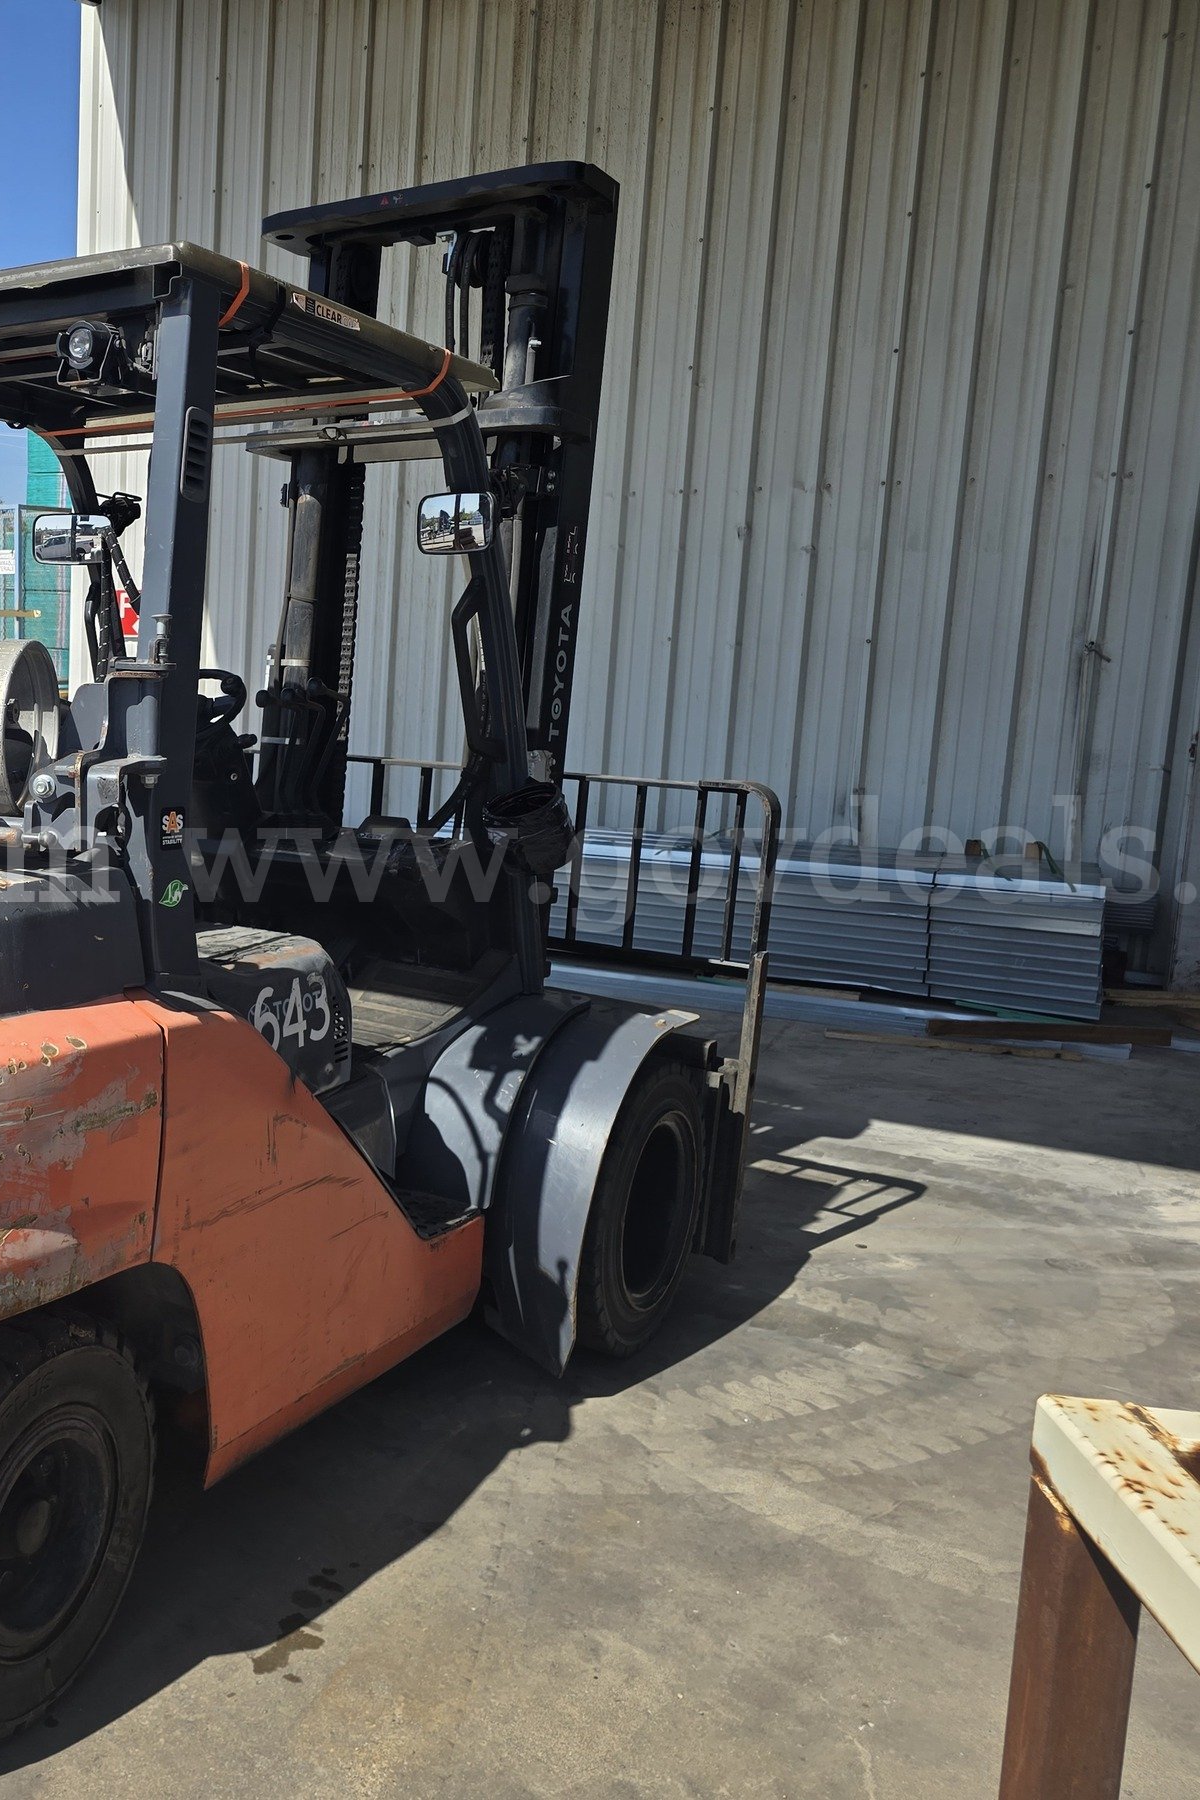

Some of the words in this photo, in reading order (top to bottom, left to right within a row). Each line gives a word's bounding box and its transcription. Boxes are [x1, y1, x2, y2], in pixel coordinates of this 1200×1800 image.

[548, 604, 573, 742] TOYOTA
[162, 811, 184, 834] SAS
[254, 972, 331, 1052] 643
